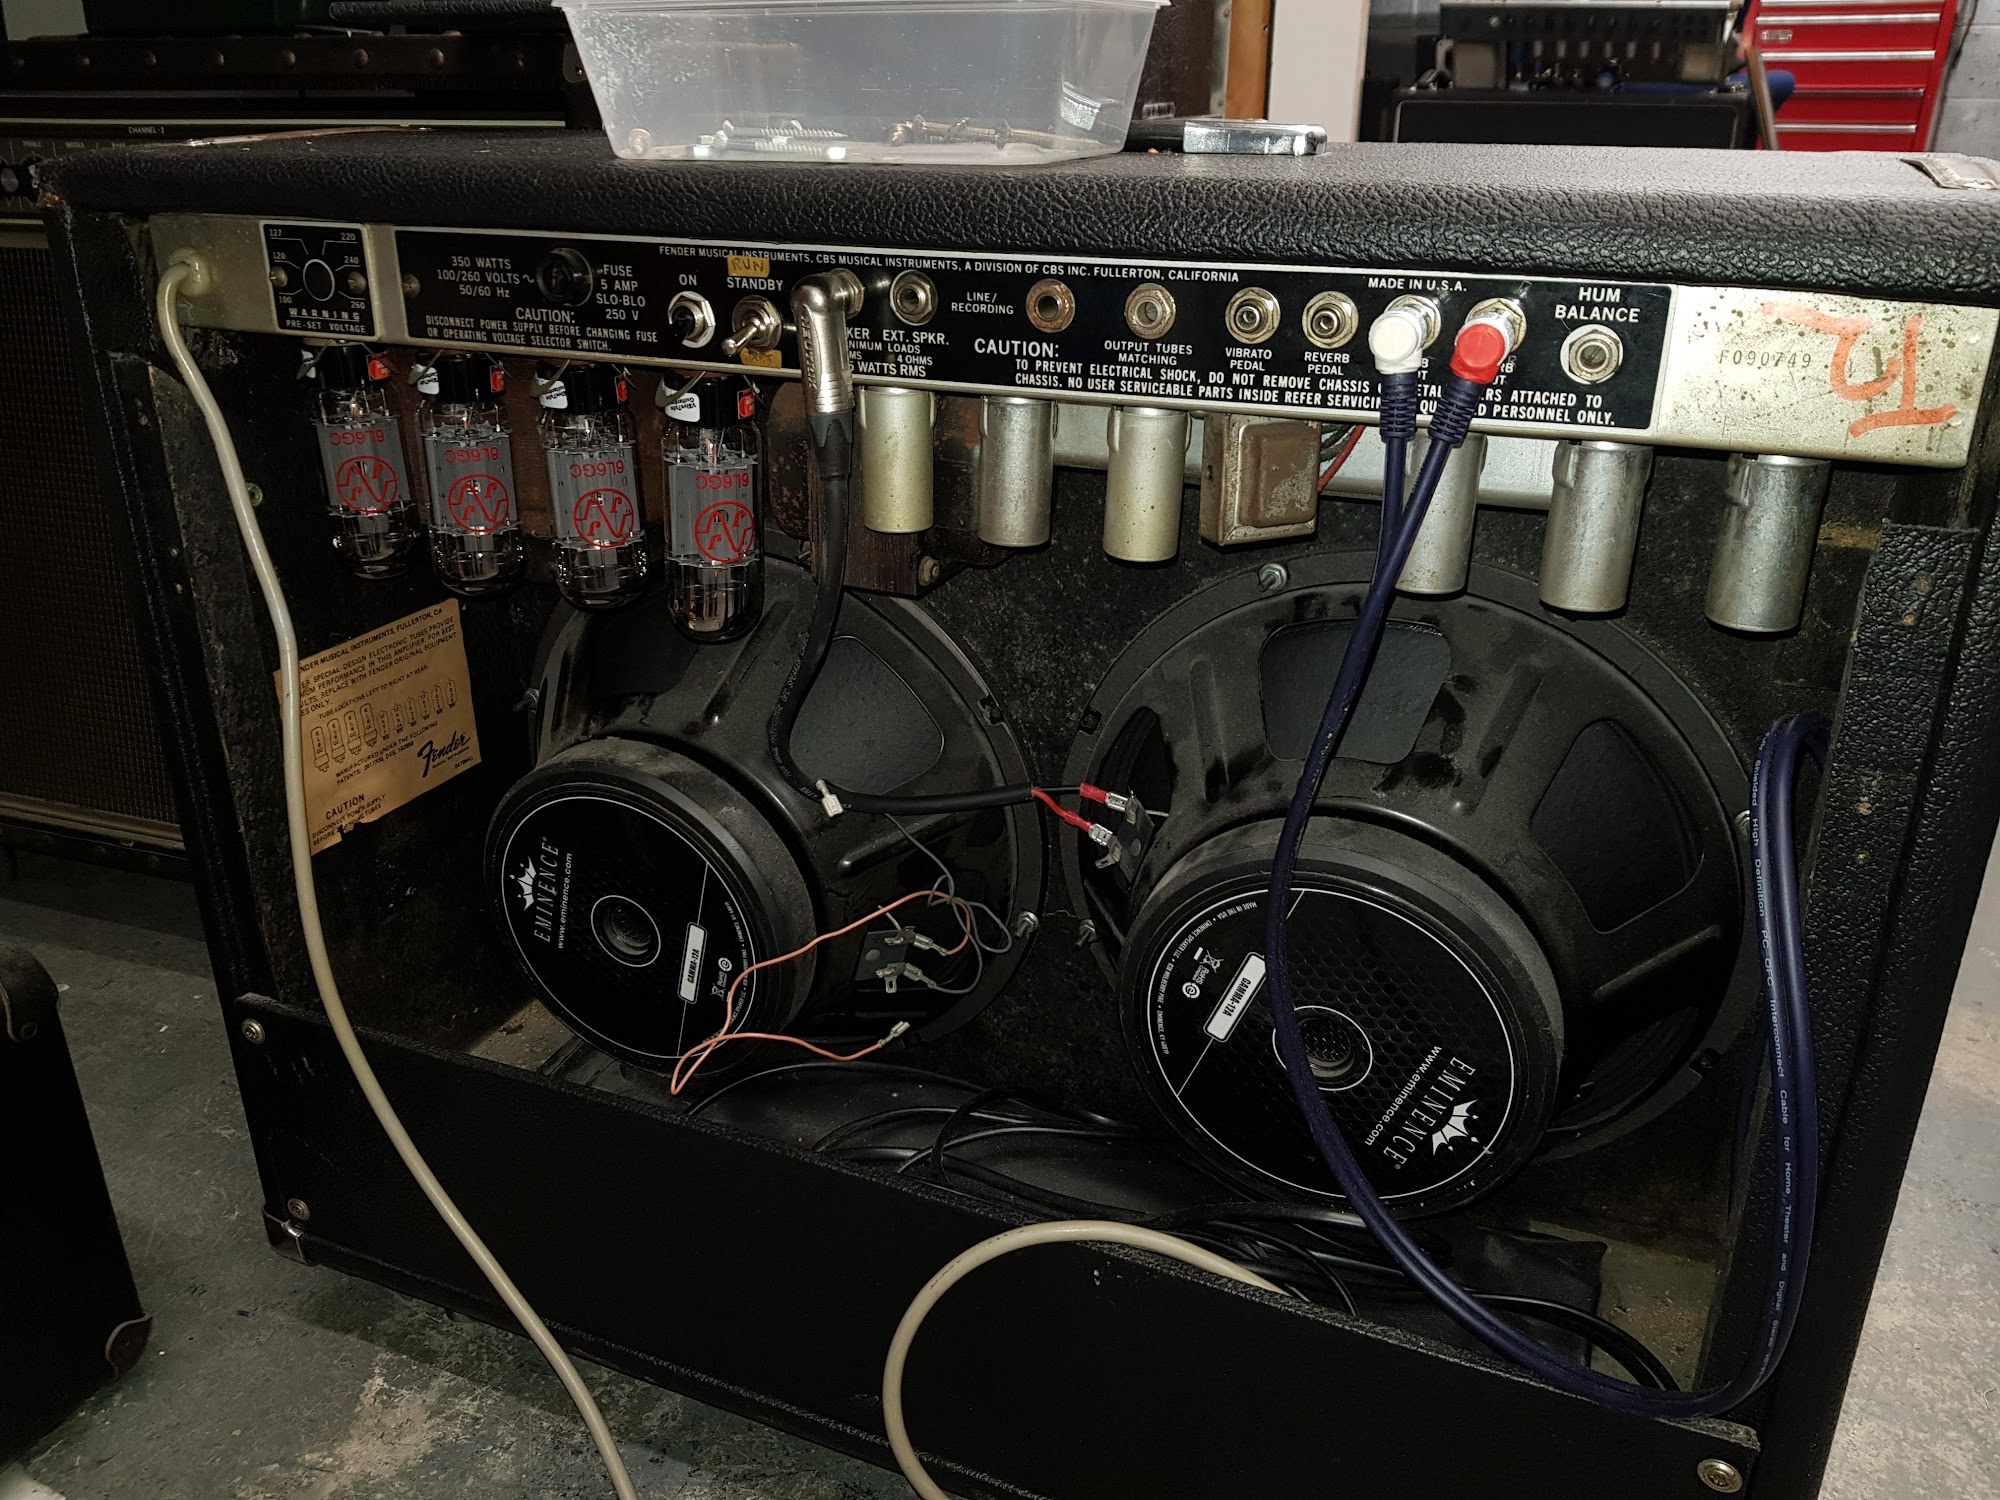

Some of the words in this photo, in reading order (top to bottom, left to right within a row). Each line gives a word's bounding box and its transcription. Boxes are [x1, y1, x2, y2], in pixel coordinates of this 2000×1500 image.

[269, 228, 282, 237] 127
[340, 232, 356, 240] 220
[272, 252, 286, 260] 120
[344, 256, 360, 264] 240
[451, 256, 471, 268] 350
[476, 257, 512, 270] WATTS
[660, 246, 696, 256] FENDER
[816, 254, 836, 264] CBS
[838, 255, 883, 267] MUSICAL
[885, 258, 962, 271] INSTRUMENTS,
[964, 261, 972, 271] A
[974, 262, 1022, 273] DIVISION
[1024, 264, 1040, 274] OF
[1042, 264, 1065, 276] CBS
[1068, 265, 1092, 276] INC.
[1094, 266, 1165, 280] FULLERTON,
[1168, 270, 1240, 282] CALIFORNIA
[602, 264, 633, 278] FUSE
[731, 257, 764, 272] RUN
[437, 269, 480, 282] 100/260
[484, 271, 520, 284] VOLTS
[679, 274, 698, 286] ON
[726, 277, 784, 292] STANDBY
[1368, 277, 1404, 290] MADE
[1409, 278, 1422, 290] IN
[1426, 280, 1468, 292] U.S.A.
[459, 284, 492, 297] 50/60
[496, 286, 510, 298] Hz
[600, 279, 608, 290] 5
[614, 280, 638, 292] AMP
[278, 296, 292, 304] 100
[596, 294, 646, 308] SLO-BLO
[966, 292, 998, 304] LINE/
[1578, 286, 1621, 303] HUM
[350, 300, 366, 310] 260
[951, 302, 1014, 316] RECORDING
[288, 308, 360, 320] WARNING
[515, 306, 576, 324] CAUTION:
[605, 308, 626, 320] 250
[631, 310, 640, 321] V
[1554, 304, 1641, 324] BALANCE
[286, 320, 322, 330] PRE-SET
[328, 322, 366, 334] VOLTAGE
[426, 314, 475, 328] DISCONNECT
[480, 318, 508, 332] POWER
[512, 321, 543, 334] SUPPLY
[549, 324, 581, 336] BEFORE
[586, 327, 630, 340] CHANGING
[636, 330, 658, 343] FUSE
[427, 327, 438, 338] OR
[443, 328, 488, 342] OPERATING
[492, 332, 526, 345] VOLTAGE
[530, 336, 572, 348] SELECTOR
[576, 338, 612, 352] SWITCH.
[882, 330, 910, 344] EXT.
[912, 332, 950, 346] SPKR.
[848, 340, 882, 352] NIMUM
[888, 342, 921, 354] LOADS
[974, 338, 1060, 358] CAUTION:
[1104, 340, 1150, 352] OUTPUT
[1155, 342, 1194, 356] TUBES
[1225, 347, 1273, 360] VIBRATO
[896, 354, 904, 364] 4
[904, 355, 933, 366] OHMS
[1118, 352, 1178, 366] MATCHING
[1304, 351, 1350, 364] REVERB
[1718, 350, 1812, 368] F090749
[857, 362, 898, 376] WATTS
[900, 364, 926, 378] RMS
[1230, 360, 1266, 372] PEDAL
[1308, 364, 1345, 376] PEDAL
[1015, 358, 1029, 371] TO
[1035, 360, 1083, 375] PREVENT
[1090, 363, 1153, 380] ELECTRICAL
[1160, 368, 1201, 384] SHOCK,
[1208, 372, 1226, 384] DO
[1232, 372, 1255, 386] NOT
[1262, 373, 1312, 390] REMOVE
[1318, 377, 1370, 394] CHASSIS
[1510, 390, 1578, 408] ATTACHED
[1585, 394, 1602, 408] TO
[1015, 372, 1063, 388] CHASSIS.
[1068, 376, 1084, 389] NO
[1088, 377, 1116, 392] USER
[1120, 379, 1194, 398] SERVICEABLE
[1198, 384, 1234, 400] PARTS
[1238, 387, 1278, 403] INSIDE
[1284, 389, 1322, 406] REFER
[1492, 406, 1577, 423] PERSONNEL
[1580, 410, 1616, 426] ONLY.
[330, 428, 384, 446] 6L6GC
[445, 447, 500, 464] 6L6GC
[570, 460, 624, 478] 6L6GC
[695, 473, 750, 490] 6L6GC
[313, 666, 340, 684] SPECIAL
[342, 654, 367, 670] DESIGN
[368, 636, 408, 660] ELECTRONIC
[408, 628, 428, 642] TUBES
[320, 647, 350, 664] MUSICAL
[318, 664, 366, 690] PERFORMANCE
[377, 652, 393, 665] THIS
[320, 682, 350, 699] REPLACE
[350, 674, 368, 687] WITH
[368, 662, 394, 679] FENDER
[416, 730, 472, 778] Fender
[1751, 760, 1762, 806] Shielded
[325, 793, 366, 820] CAUTION
[1751, 818, 1760, 847] High
[1754, 858, 1766, 918] Definition
[557, 852, 572, 950] www.eminence.com
[1760, 929, 1775, 988] PC-OFC
[1222, 977, 1252, 1017] GAMMA-12A
[1770, 999, 1785, 1078] Interconnect
[1364, 1046, 1442, 1146] www.eminence.com
[1780, 1090, 1788, 1125] Cable
[1782, 1136, 1790, 1152] for
[1782, 1204, 1792, 1244] Theater
[1775, 1280, 1785, 1311] Digital
